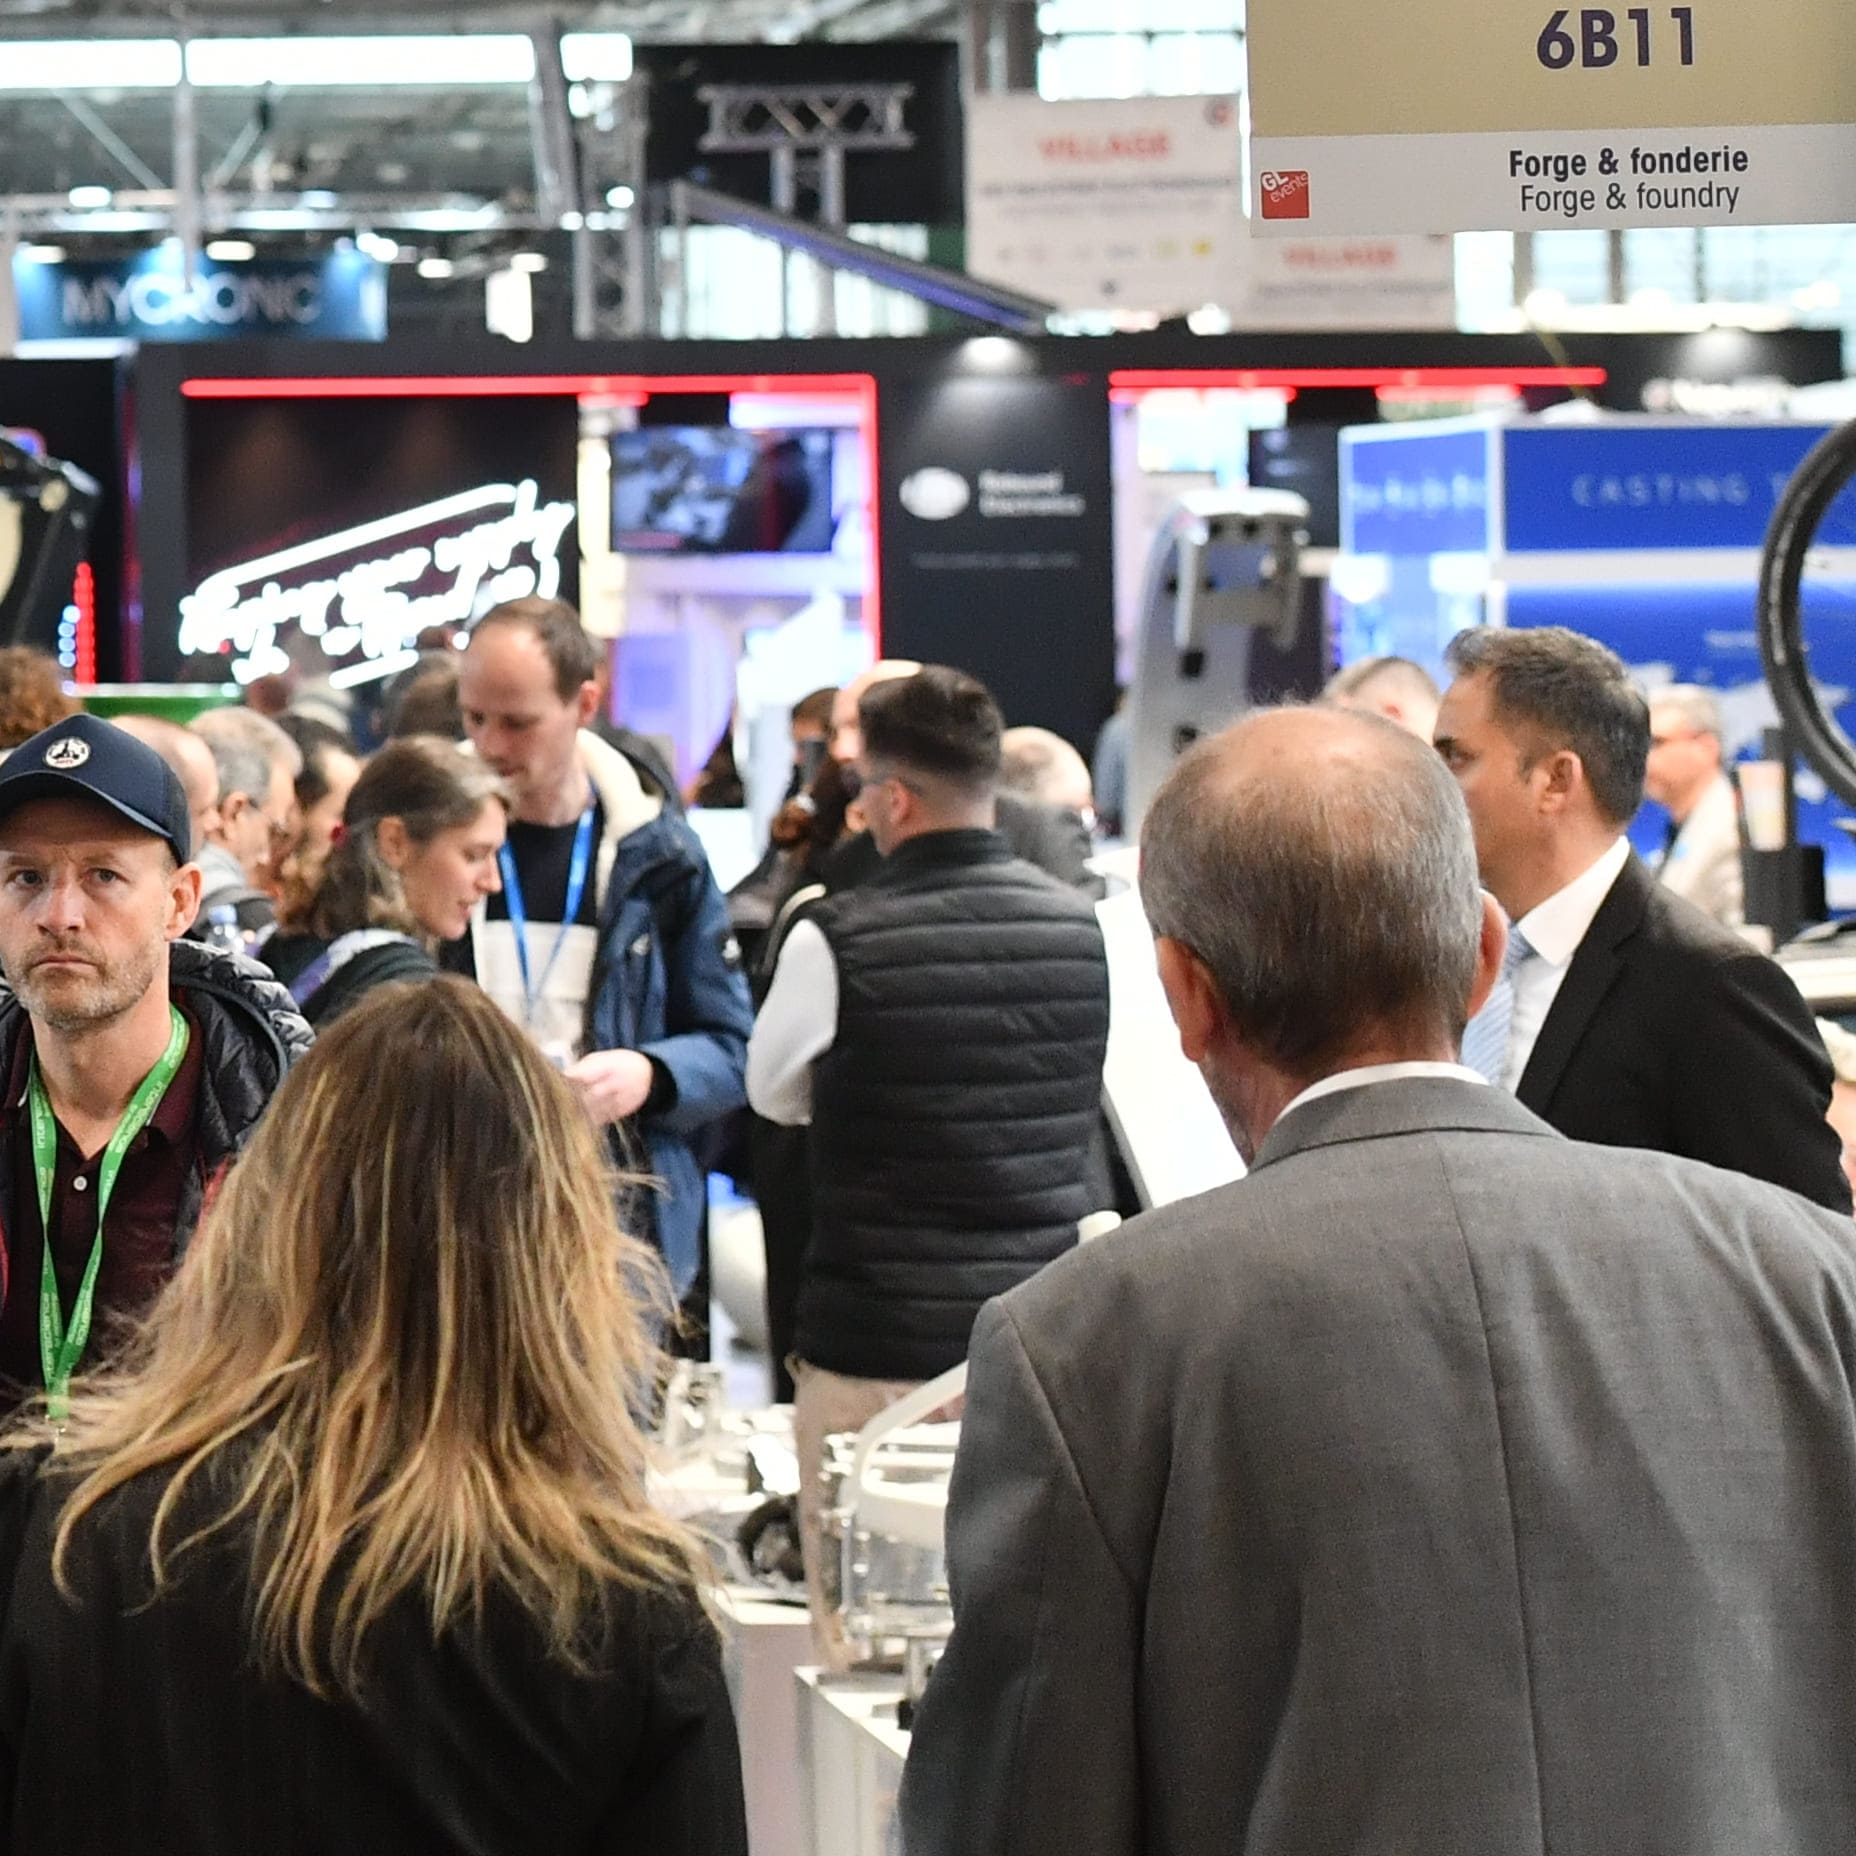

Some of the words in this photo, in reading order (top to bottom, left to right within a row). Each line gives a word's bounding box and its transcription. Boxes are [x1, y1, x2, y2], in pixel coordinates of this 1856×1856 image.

[1535, 6, 1695, 70] 6B11
[1261, 171, 1290, 191] GL
[1508, 149, 1587, 183] Forge
[1597, 148, 1620, 175] &
[1630, 145, 1750, 176] fonderie
[1520, 185, 1579, 217] Forge
[1605, 184, 1627, 211] &
[1635, 182, 1741, 214] foundry
[61, 270, 322, 325] MYCRONIC
